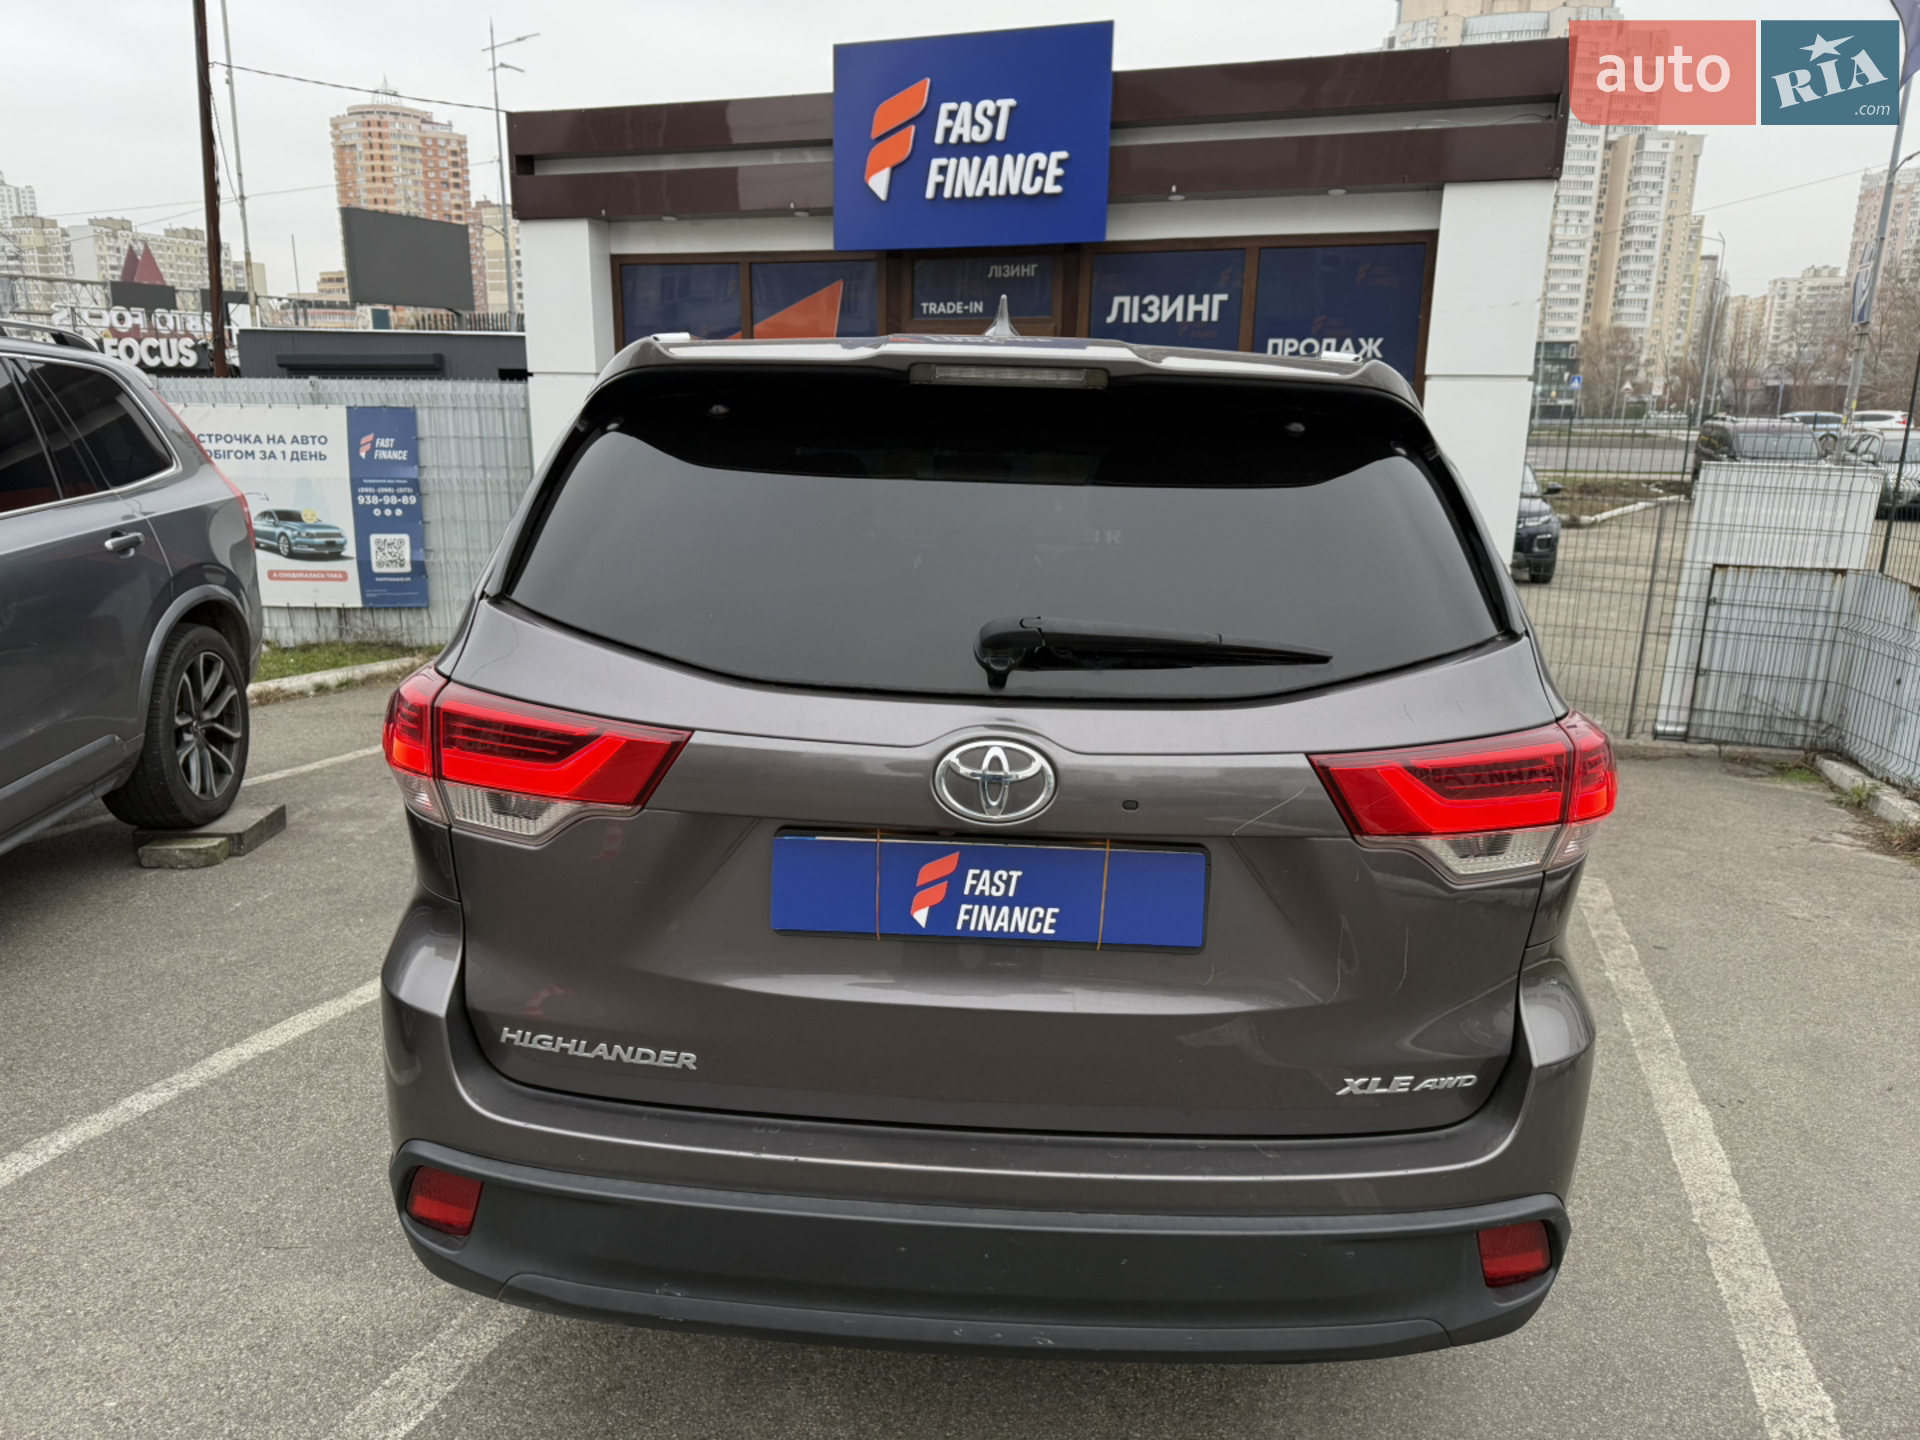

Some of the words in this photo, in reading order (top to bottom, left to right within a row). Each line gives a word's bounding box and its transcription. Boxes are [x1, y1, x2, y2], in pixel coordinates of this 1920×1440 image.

[934, 98, 1017, 145] FAST
[924, 150, 1070, 200] FINANCE
[987, 263, 1039, 279] ЛІЗИНГ
[920, 301, 984, 315] TRADE-IN
[1105, 293, 1229, 324] ЛІЗИНГ
[102, 337, 199, 367] FOCUS
[1266, 336, 1384, 360] ПРОДАЖ
[266, 434, 287, 446] НА
[290, 434, 329, 446] АВТО
[375, 437, 396, 449] FAST
[259, 450, 278, 461] ЗА
[281, 450, 287, 461] 1
[289, 450, 328, 463] ДЕНЬ
[373, 449, 409, 461] FINANCE
[356, 494, 418, 506] 938-98-89
[963, 868, 1023, 897] FAST
[956, 904, 1060, 935] FINANCE
[499, 1026, 698, 1071] HIGHLANDER
[1335, 1075, 1415, 1096] XLE
[1412, 1073, 1478, 1092] AWD
